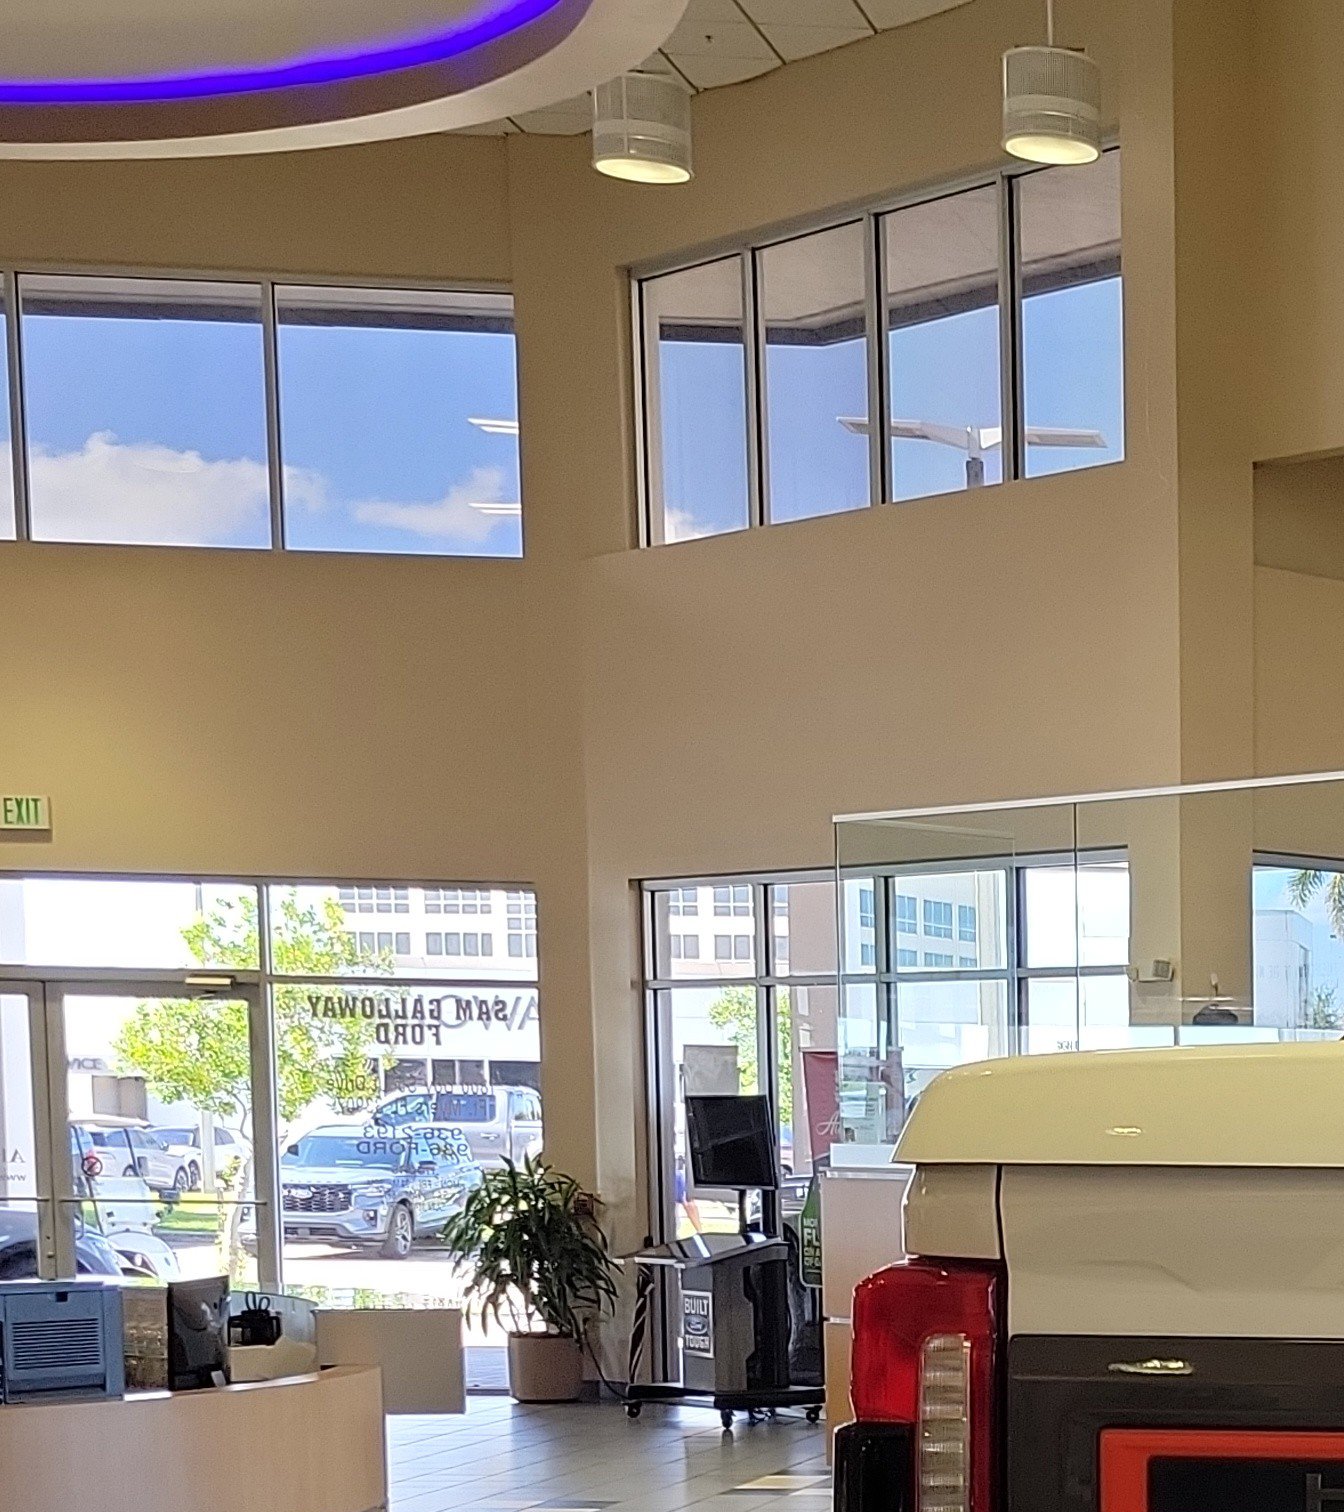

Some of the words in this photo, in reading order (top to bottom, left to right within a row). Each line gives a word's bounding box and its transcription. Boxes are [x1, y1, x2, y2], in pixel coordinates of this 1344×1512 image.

[3, 797, 42, 825] EXIT
[684, 1297, 709, 1315] BUILT
[684, 1334, 710, 1350] TOUGH
